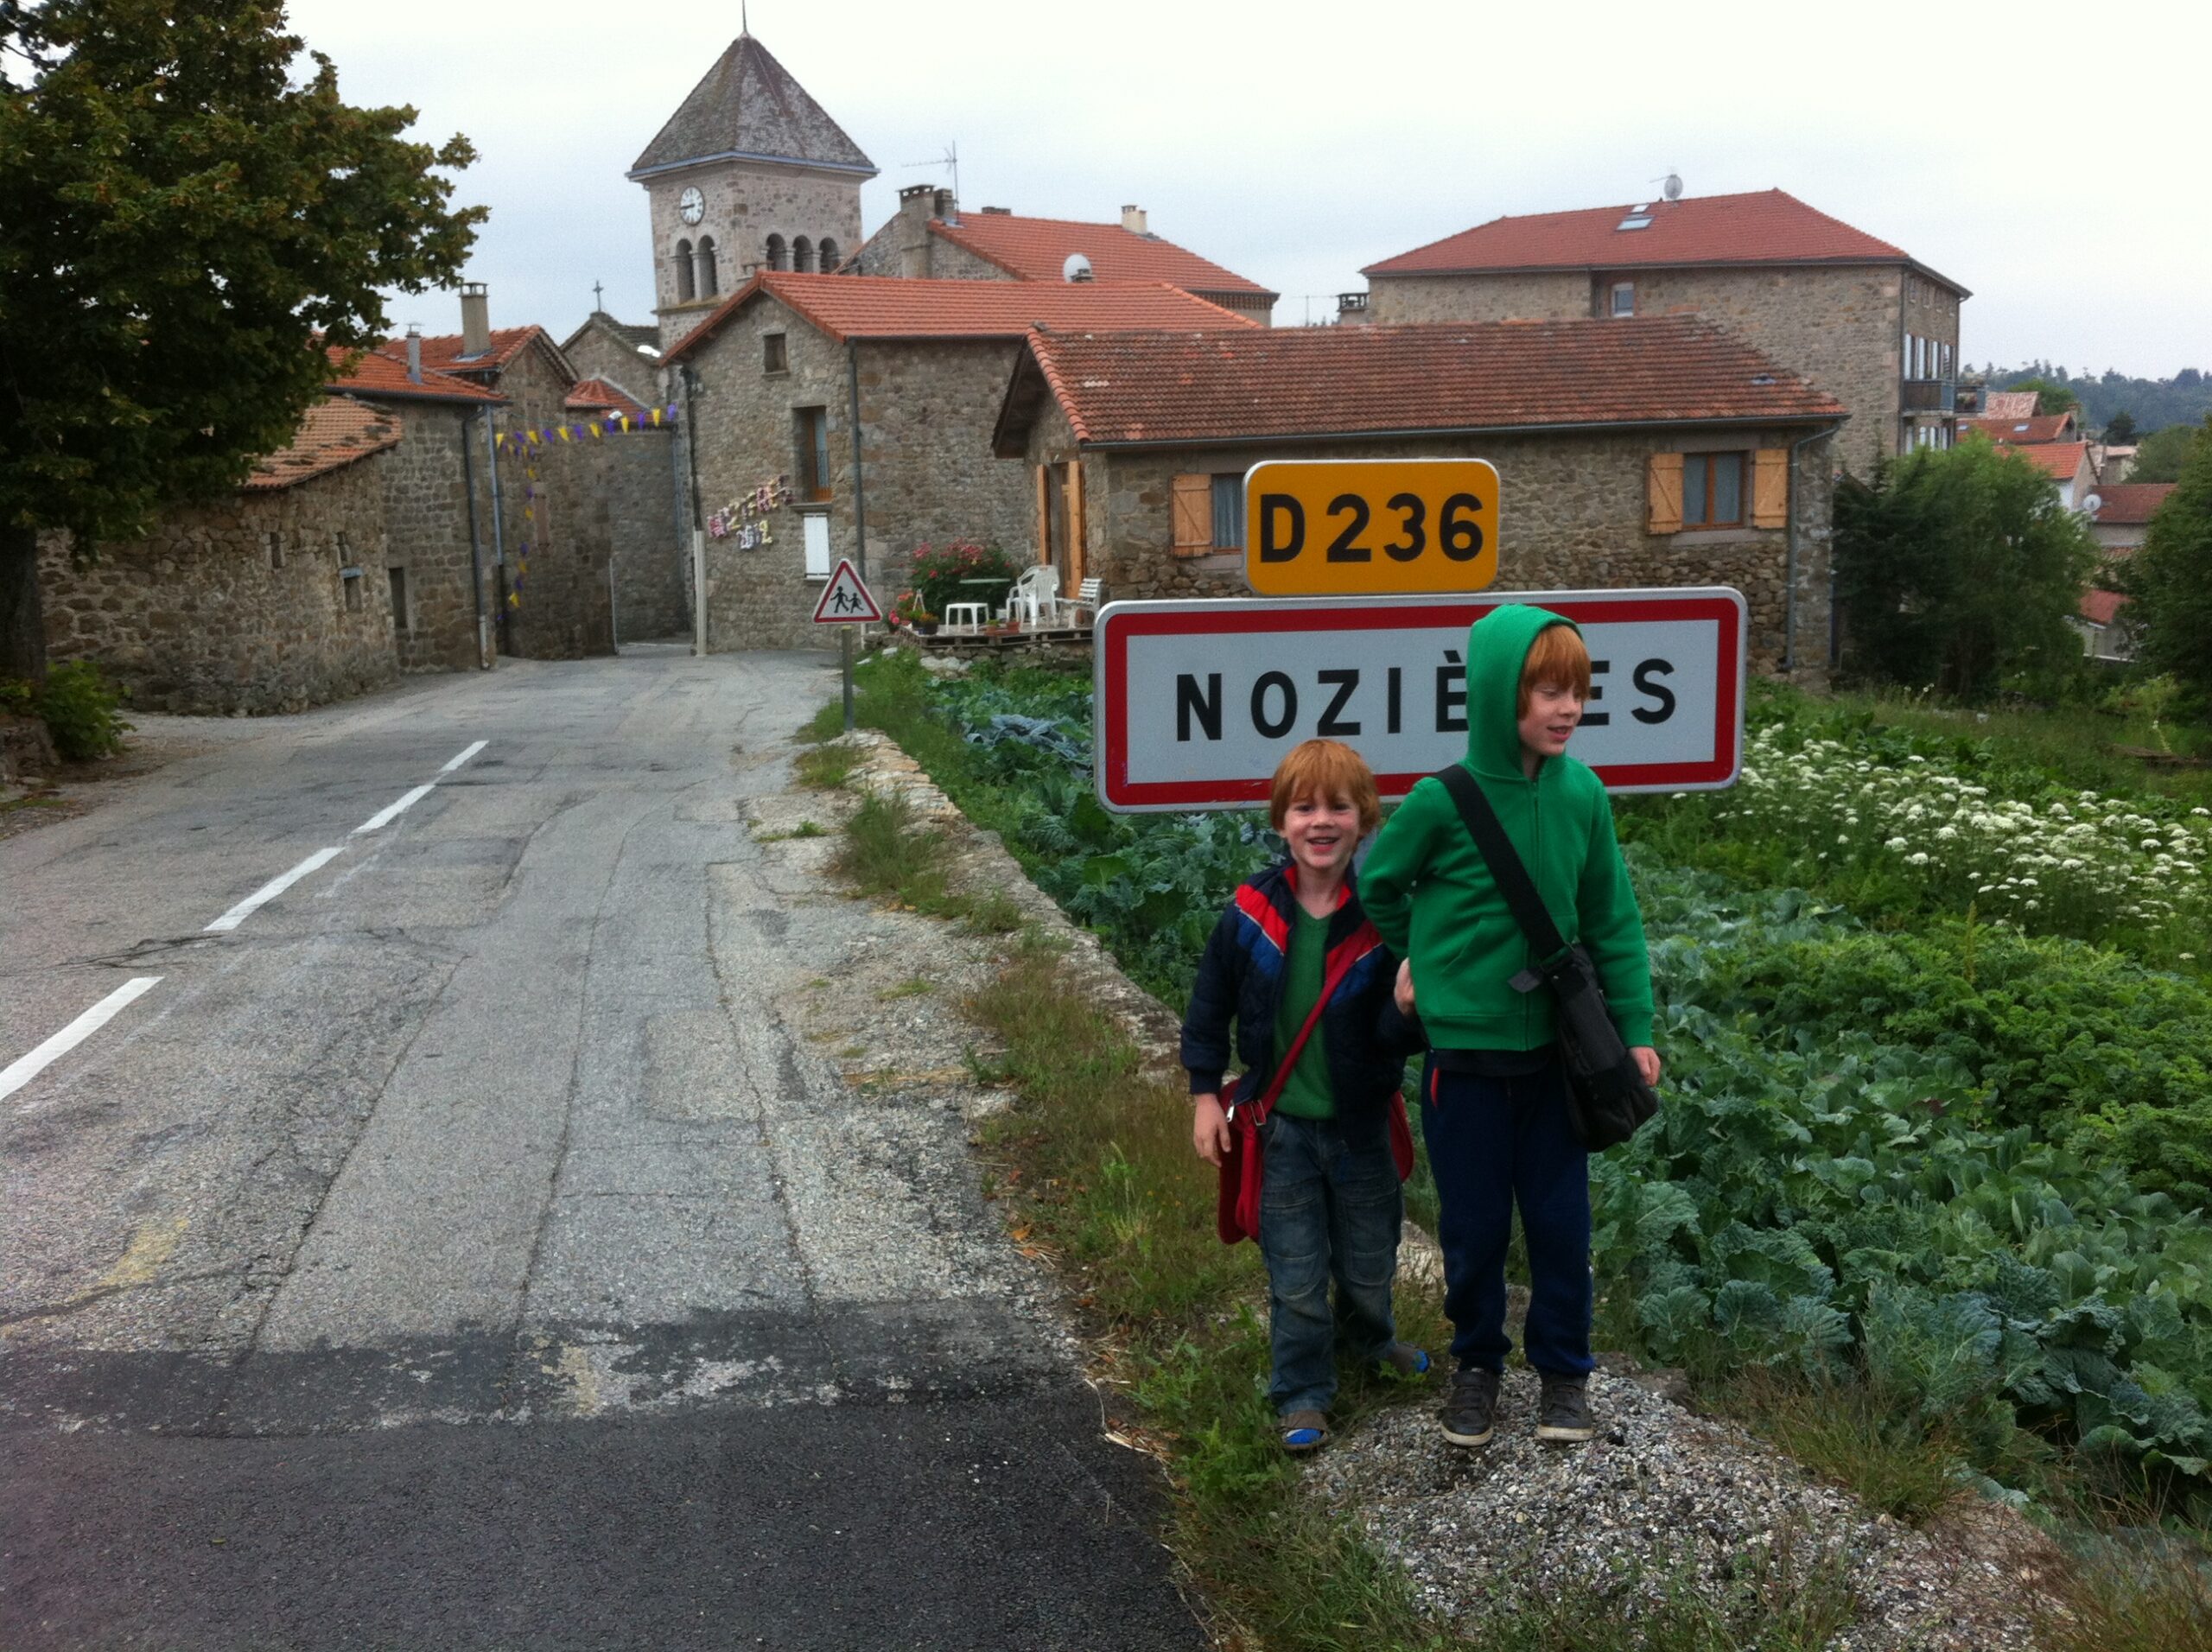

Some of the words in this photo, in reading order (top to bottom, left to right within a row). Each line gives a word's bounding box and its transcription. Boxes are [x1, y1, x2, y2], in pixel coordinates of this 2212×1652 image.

[1260, 493, 1306, 563] D
[1325, 492, 1484, 563] 236
[1176, 649, 1676, 742] NOZIÈES
